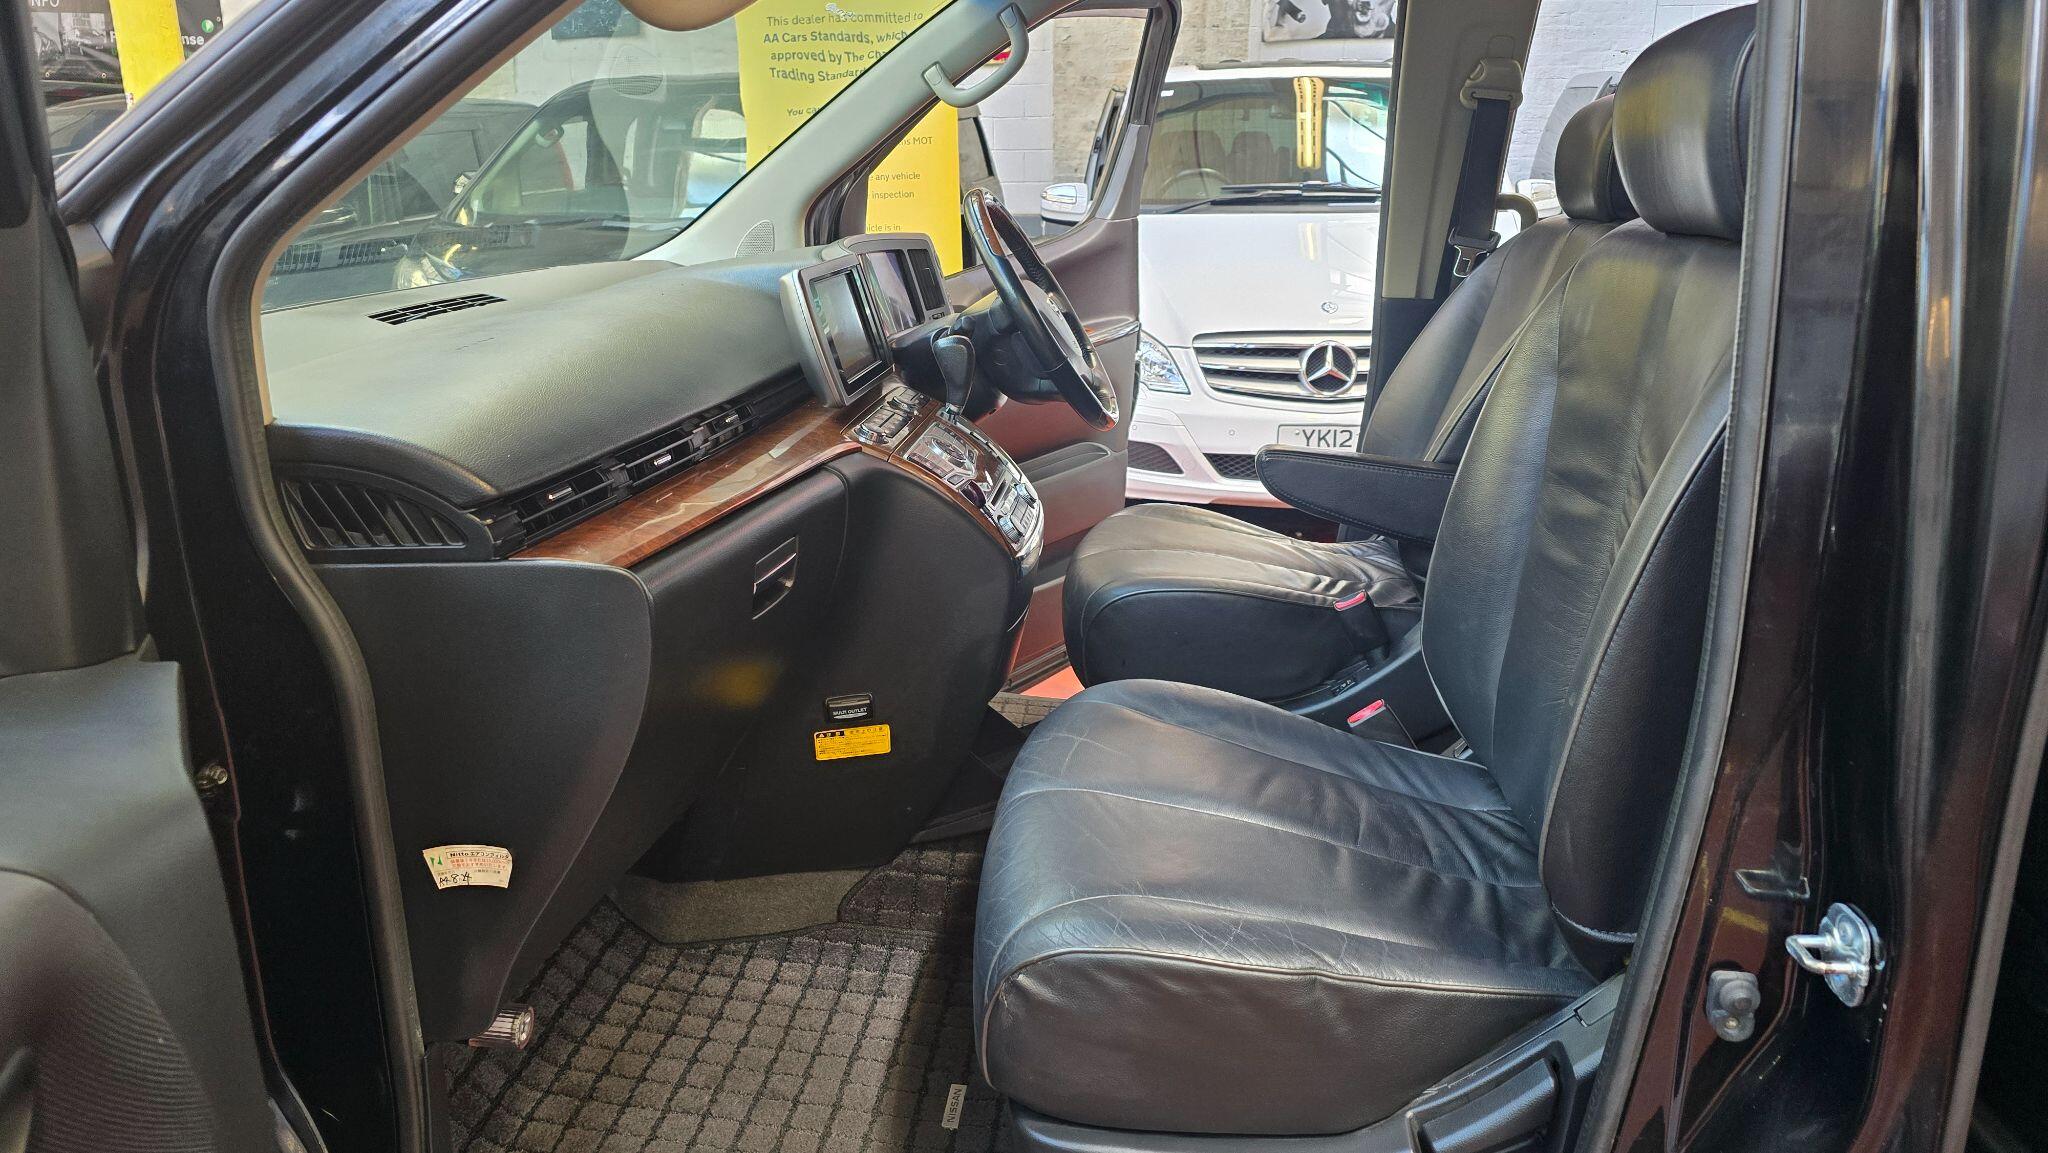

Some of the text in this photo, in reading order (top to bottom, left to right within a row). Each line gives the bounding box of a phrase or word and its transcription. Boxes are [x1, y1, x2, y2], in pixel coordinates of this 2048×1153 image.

[767, 11, 924, 26] This dealer has committed to
[763, 29, 908, 45] AA Cars Standards, which
[770, 50, 887, 65] approved by The Ch
[769, 67, 815, 83] Trading
[787, 108, 804, 117] You
[912, 136, 933, 145] MOT
[875, 174, 890, 182] any
[891, 172, 921, 181] vehicle
[872, 190, 915, 199] inspection
[884, 223, 892, 231] is
[893, 222, 901, 231] in
[1302, 429, 1353, 448] YK12
[947, 1088, 963, 1123] NISSAN
